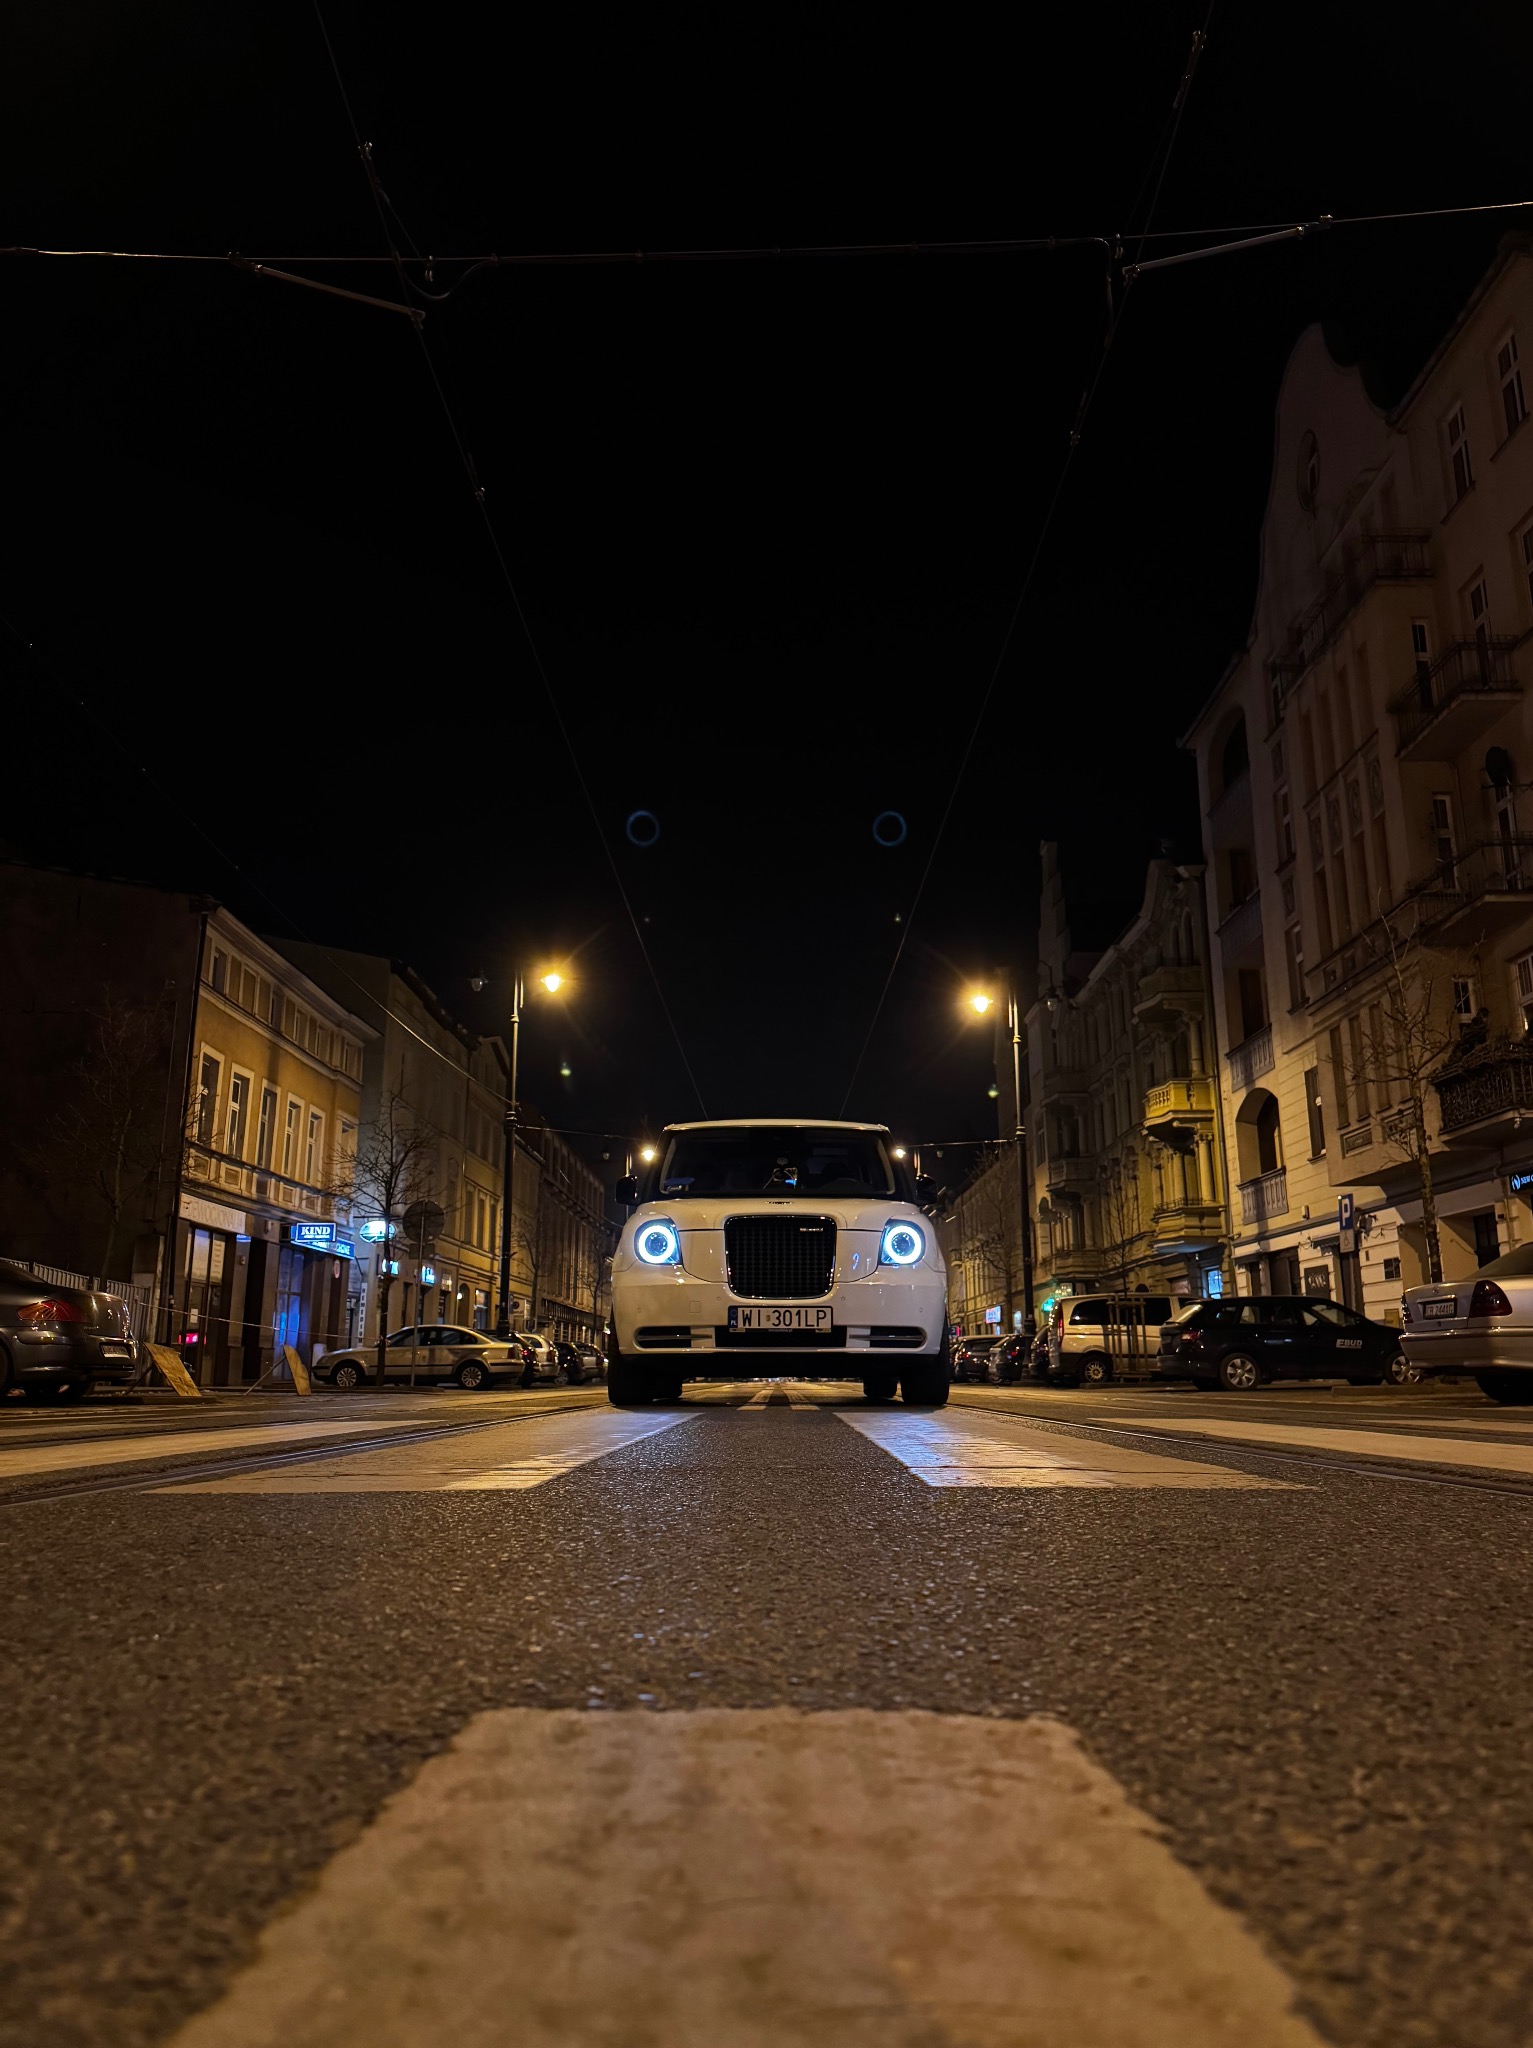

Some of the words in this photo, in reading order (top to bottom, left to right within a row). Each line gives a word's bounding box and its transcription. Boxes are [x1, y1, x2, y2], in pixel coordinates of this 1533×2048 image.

[1341, 1198, 1351, 1227] P
[301, 1226, 331, 1236] KIND
[742, 1309, 761, 1327] WI
[772, 1309, 827, 1327] 301LP
